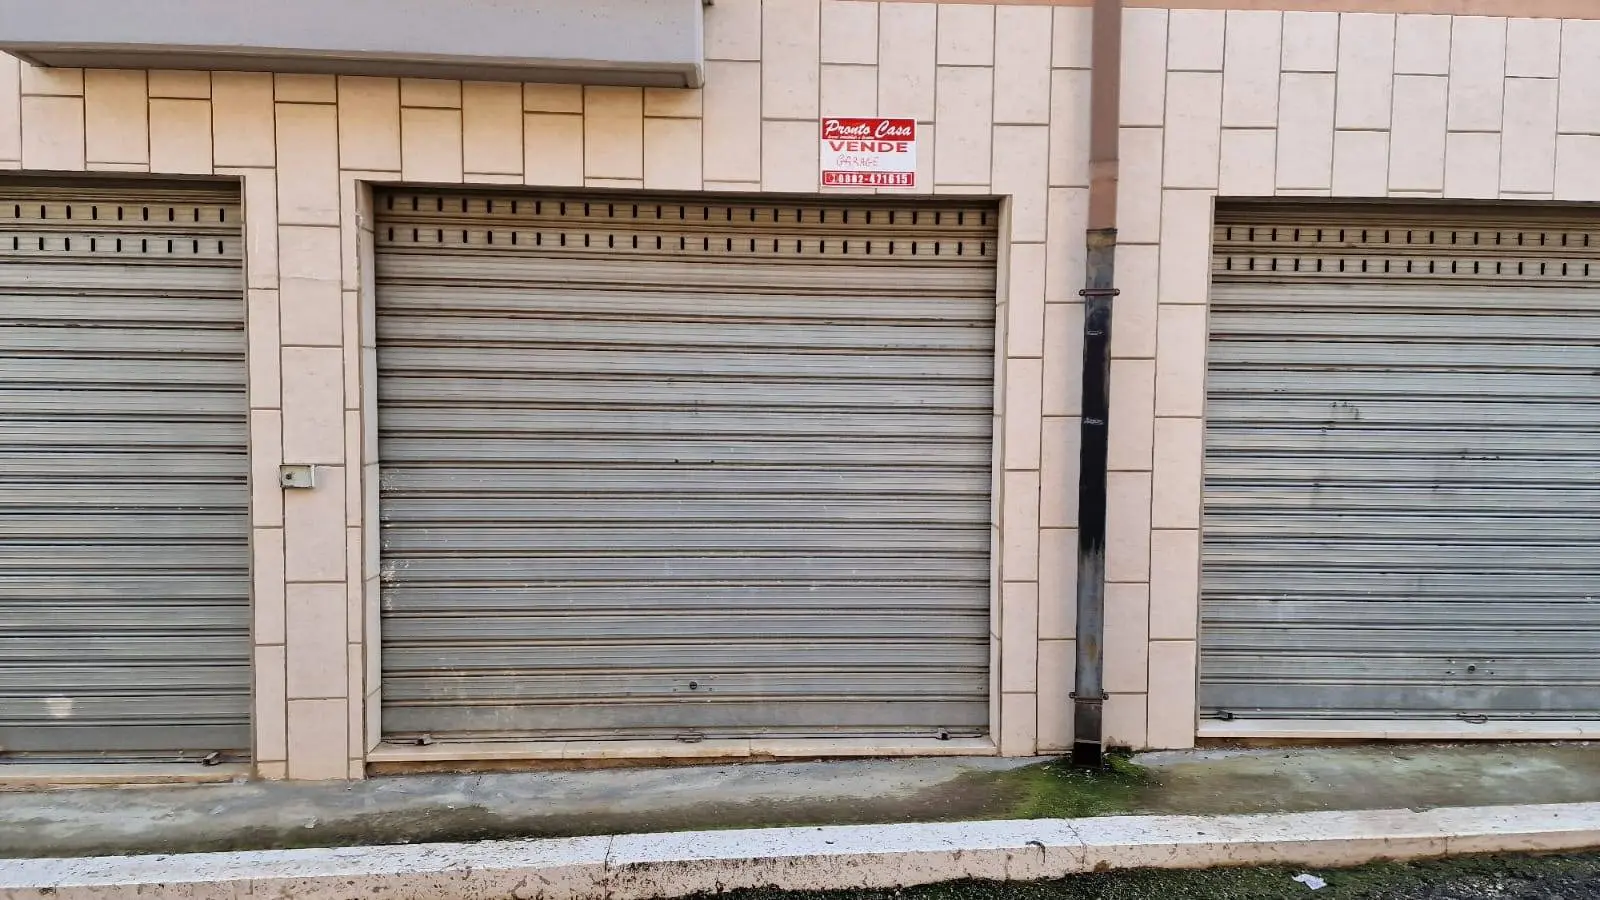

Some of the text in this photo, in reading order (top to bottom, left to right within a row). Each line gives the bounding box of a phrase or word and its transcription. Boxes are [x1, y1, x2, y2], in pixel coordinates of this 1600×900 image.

[826, 120, 911, 138] Pronto Casa
[829, 141, 908, 152] VENDE
